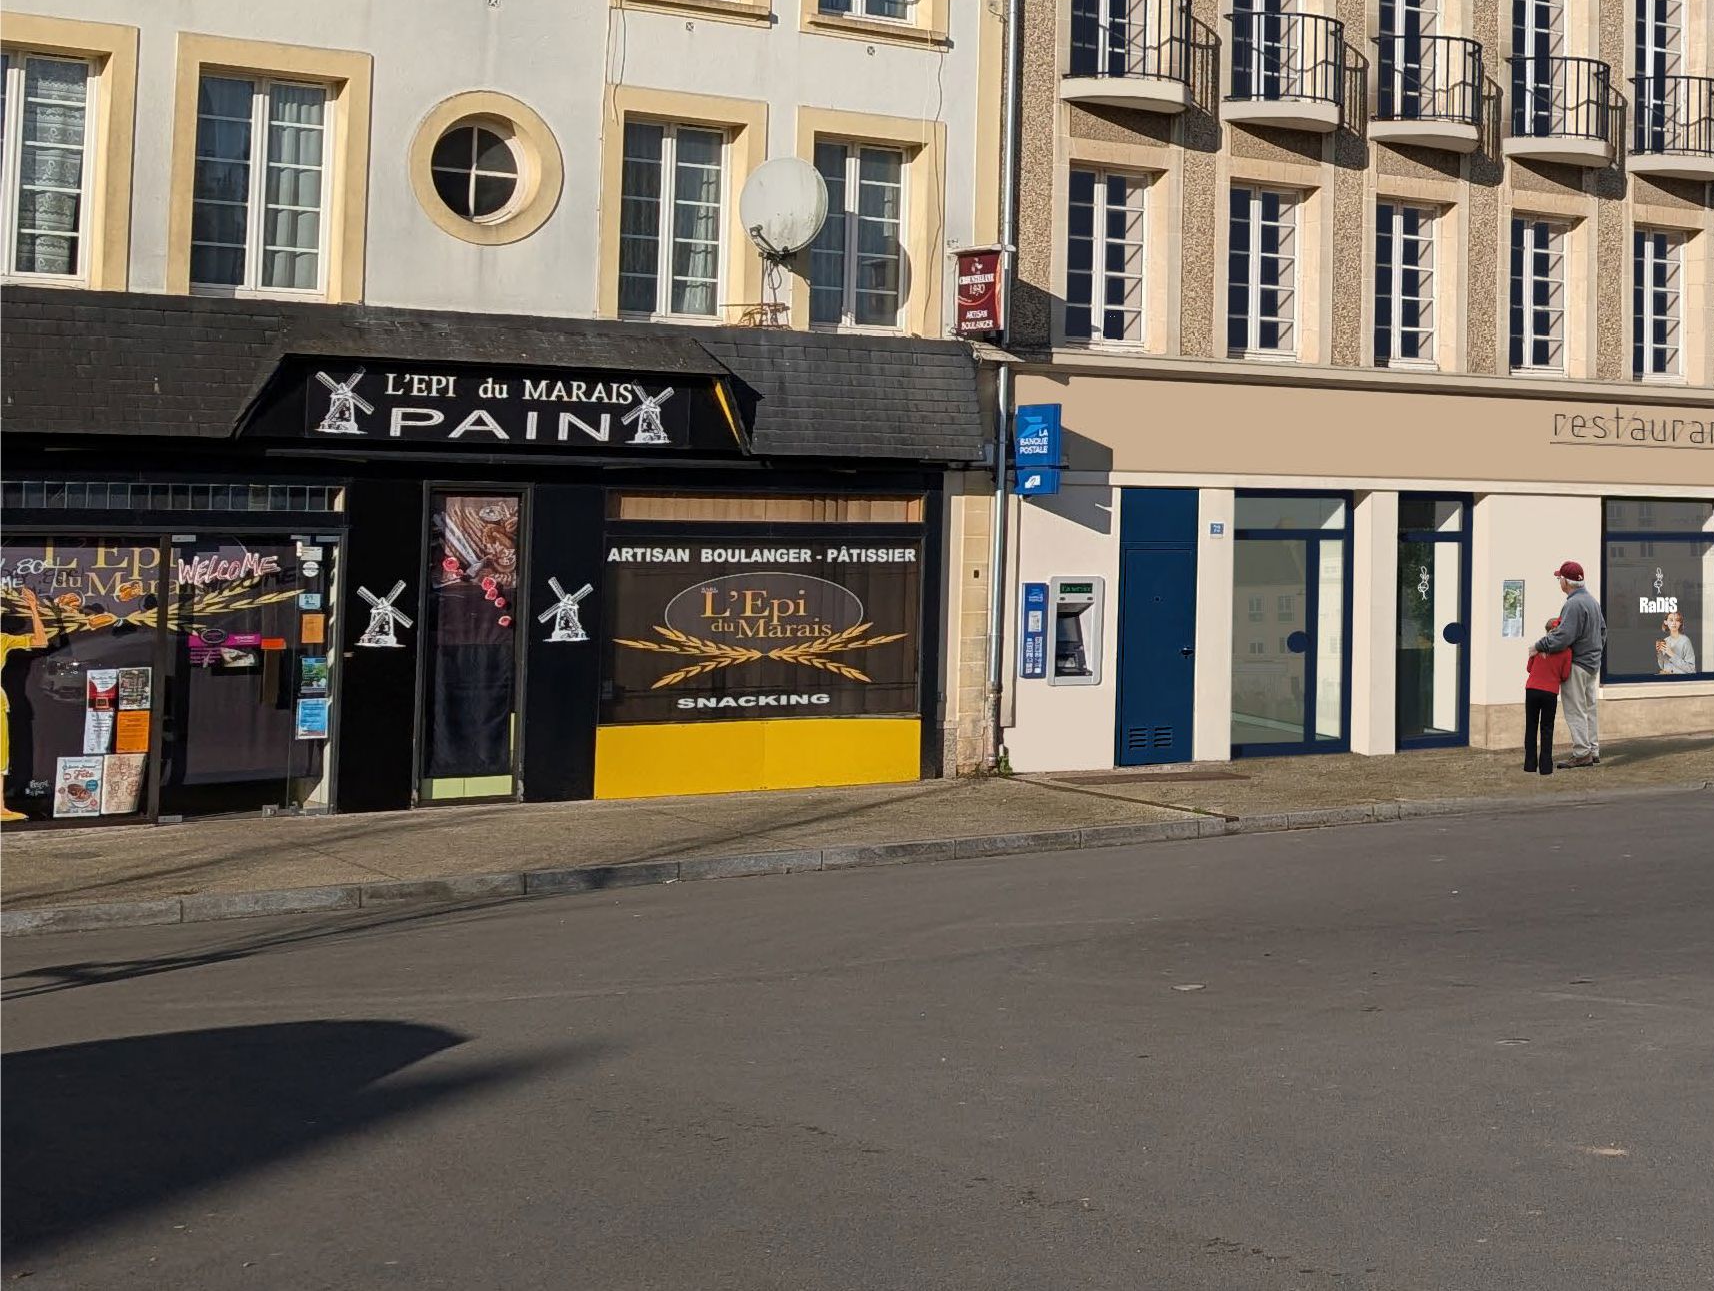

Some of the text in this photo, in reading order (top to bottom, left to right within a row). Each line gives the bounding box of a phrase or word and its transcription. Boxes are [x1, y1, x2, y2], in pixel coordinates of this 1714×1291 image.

[961, 320, 994, 330] BOULANGER
[384, 373, 633, 405] L'EPI du MARAIS
[389, 407, 611, 442] PAIN
[1039, 429, 1049, 437] LA
[1019, 438, 1048, 446] BANQUE
[1019, 446, 1048, 454] POSTALE
[607, 547, 690, 563] ARTISAN
[700, 548, 812, 563] BOULANGER
[827, 546, 917, 563] PÂTISSIER
[178, 552, 281, 585] WELCOME
[700, 589, 809, 625] L'Epi
[711, 618, 832, 639] du Marais
[677, 693, 831, 709] SNACKING
